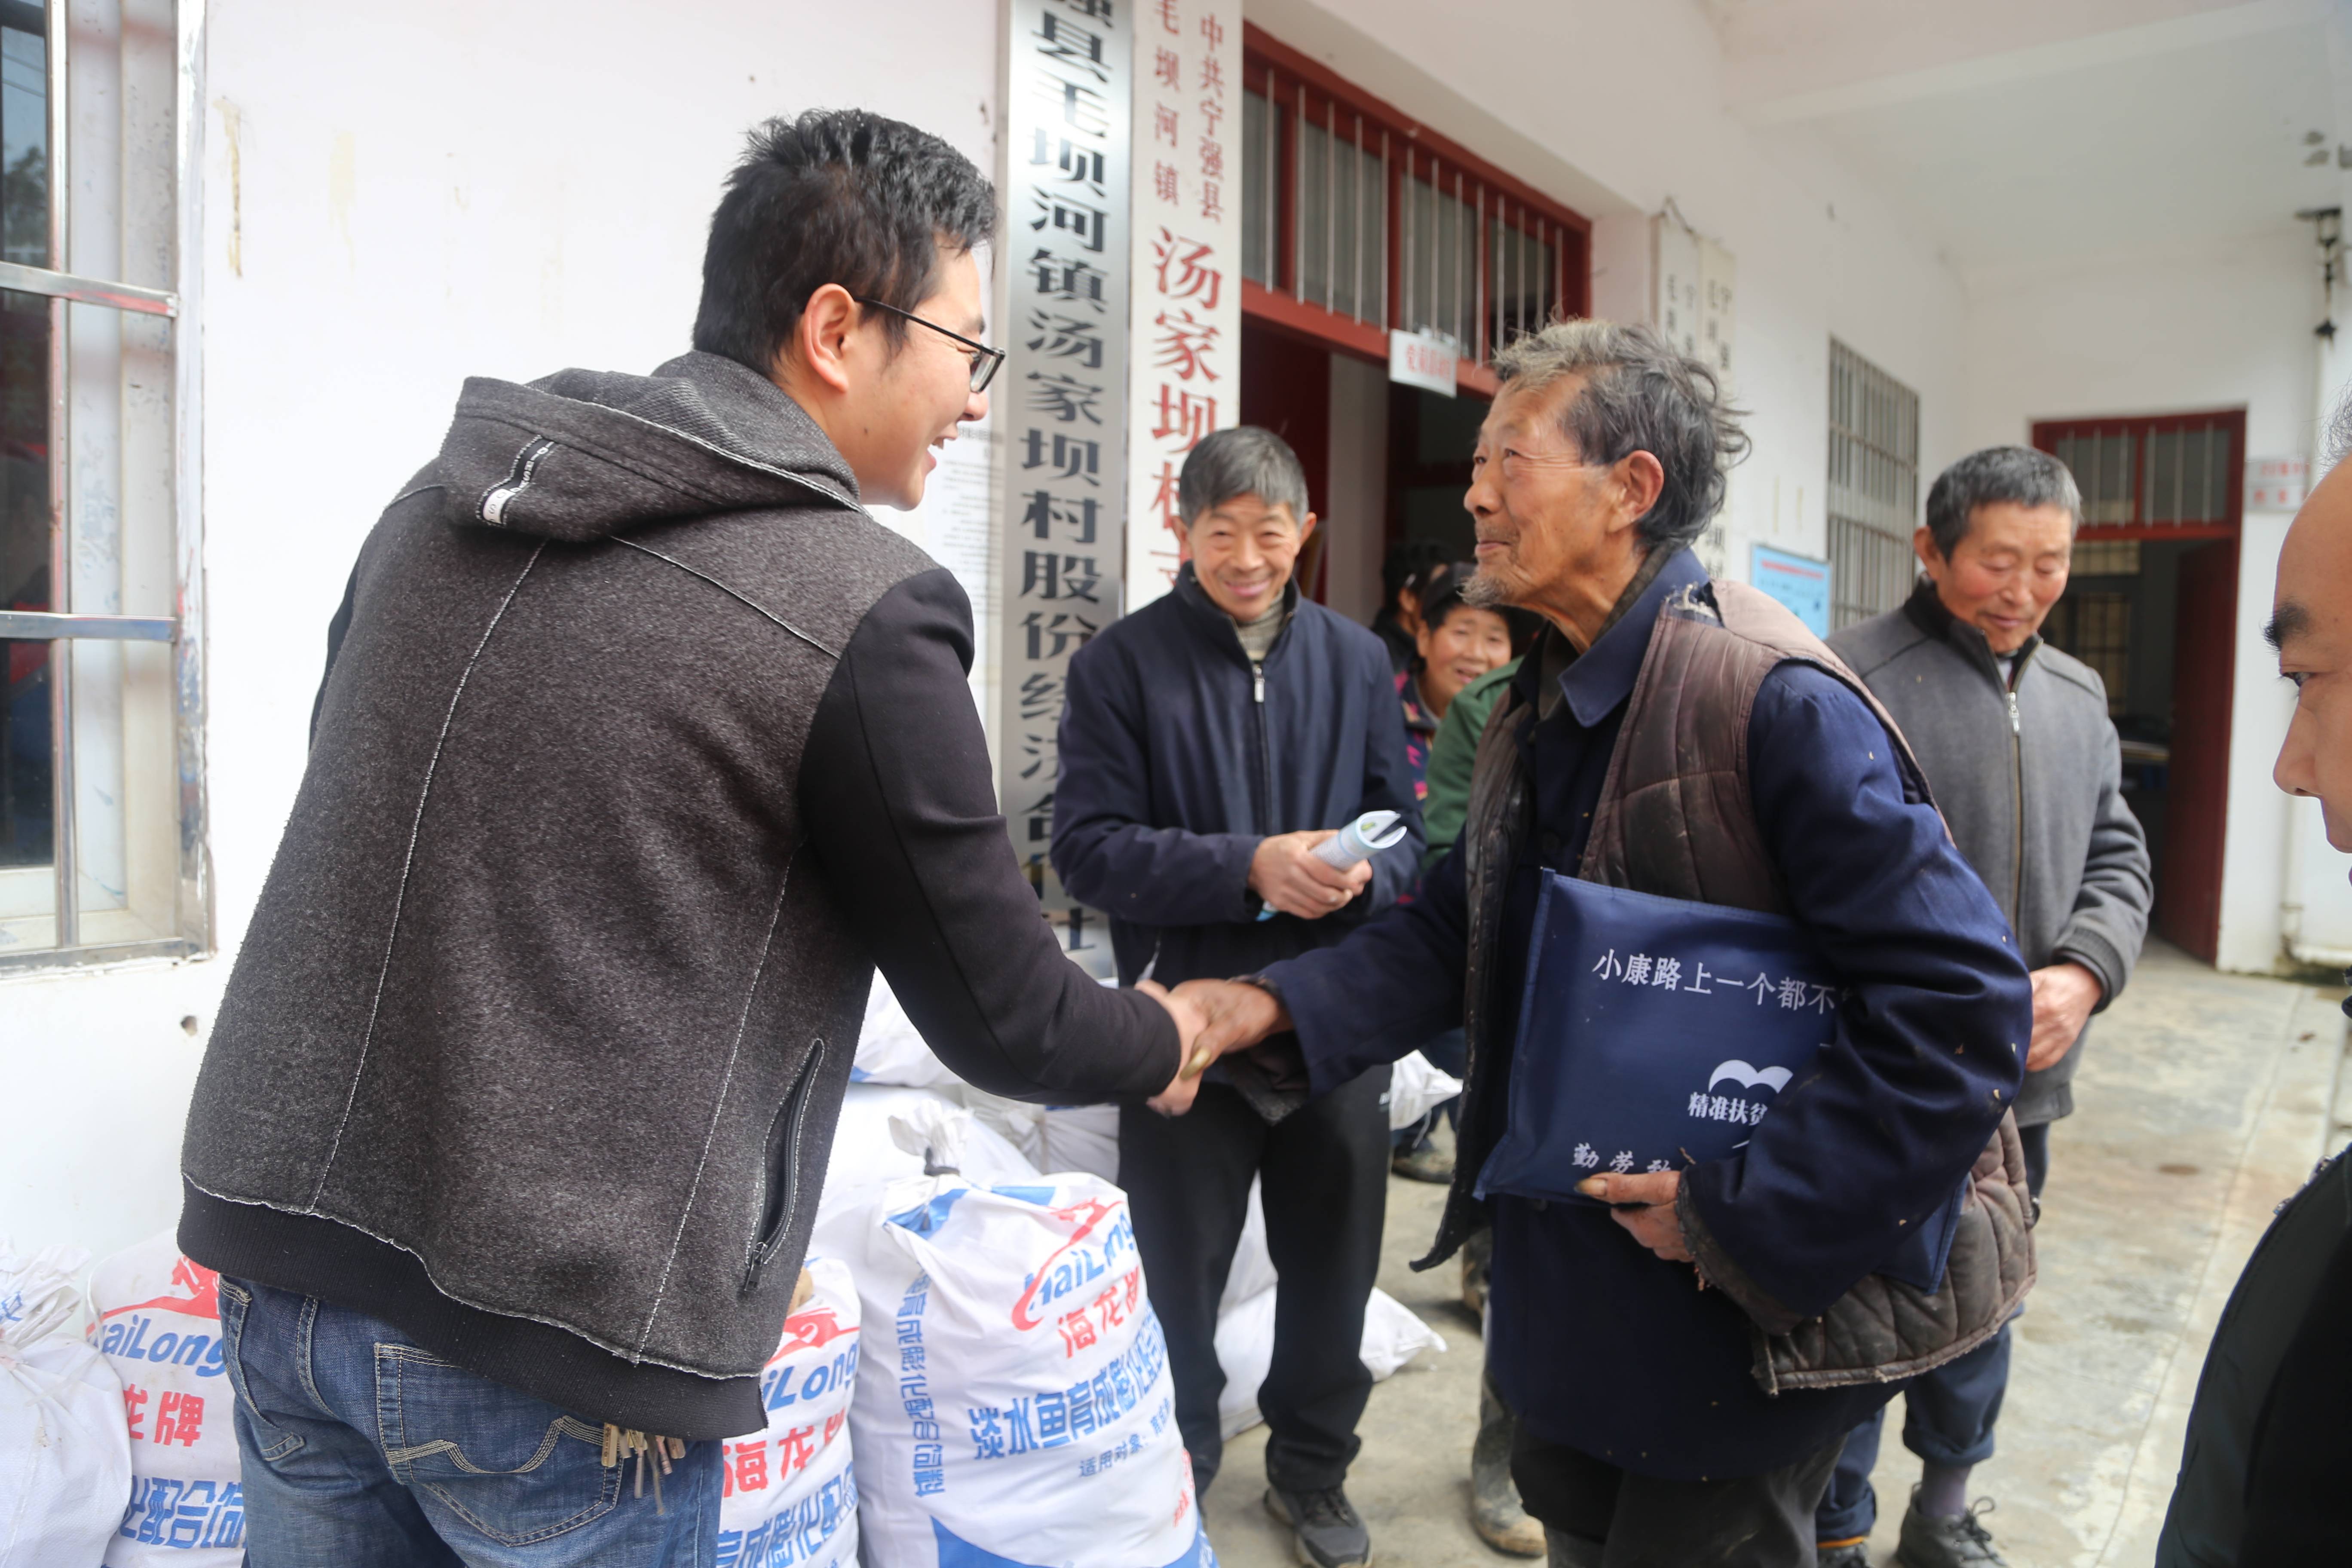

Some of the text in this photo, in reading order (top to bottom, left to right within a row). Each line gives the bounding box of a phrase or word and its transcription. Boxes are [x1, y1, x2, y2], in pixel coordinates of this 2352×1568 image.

[1199, 12, 1225, 224] 中共宁强县
